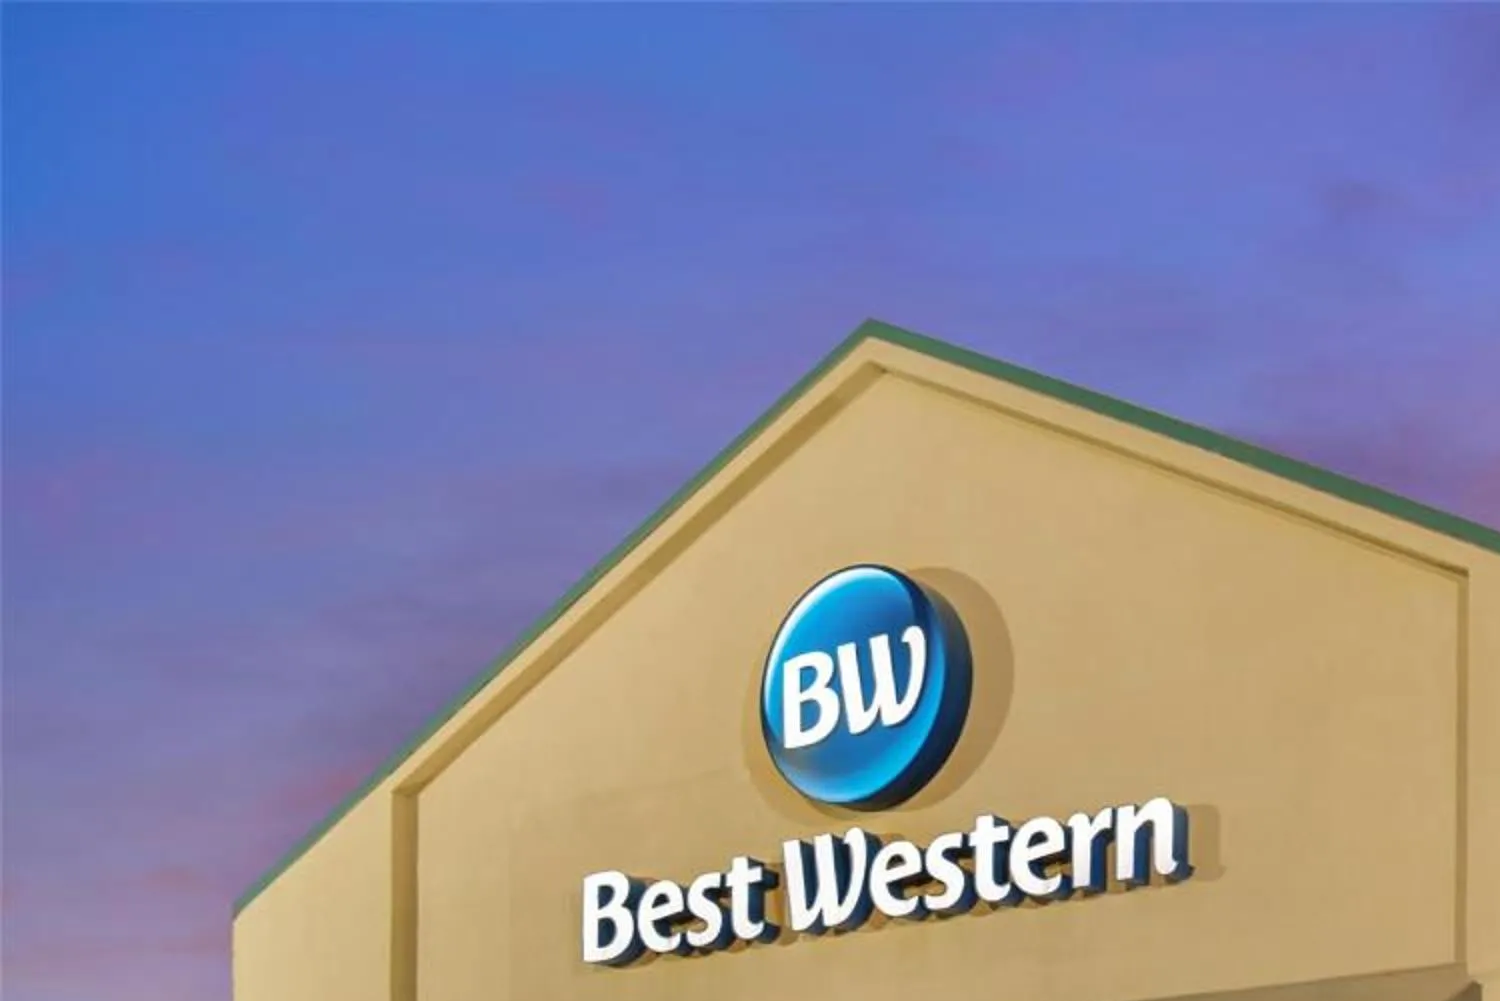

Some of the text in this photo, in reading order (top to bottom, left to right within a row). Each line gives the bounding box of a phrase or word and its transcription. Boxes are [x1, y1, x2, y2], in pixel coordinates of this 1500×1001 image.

[782, 625, 926, 749] BW
[582, 797, 1179, 963] Best Western
